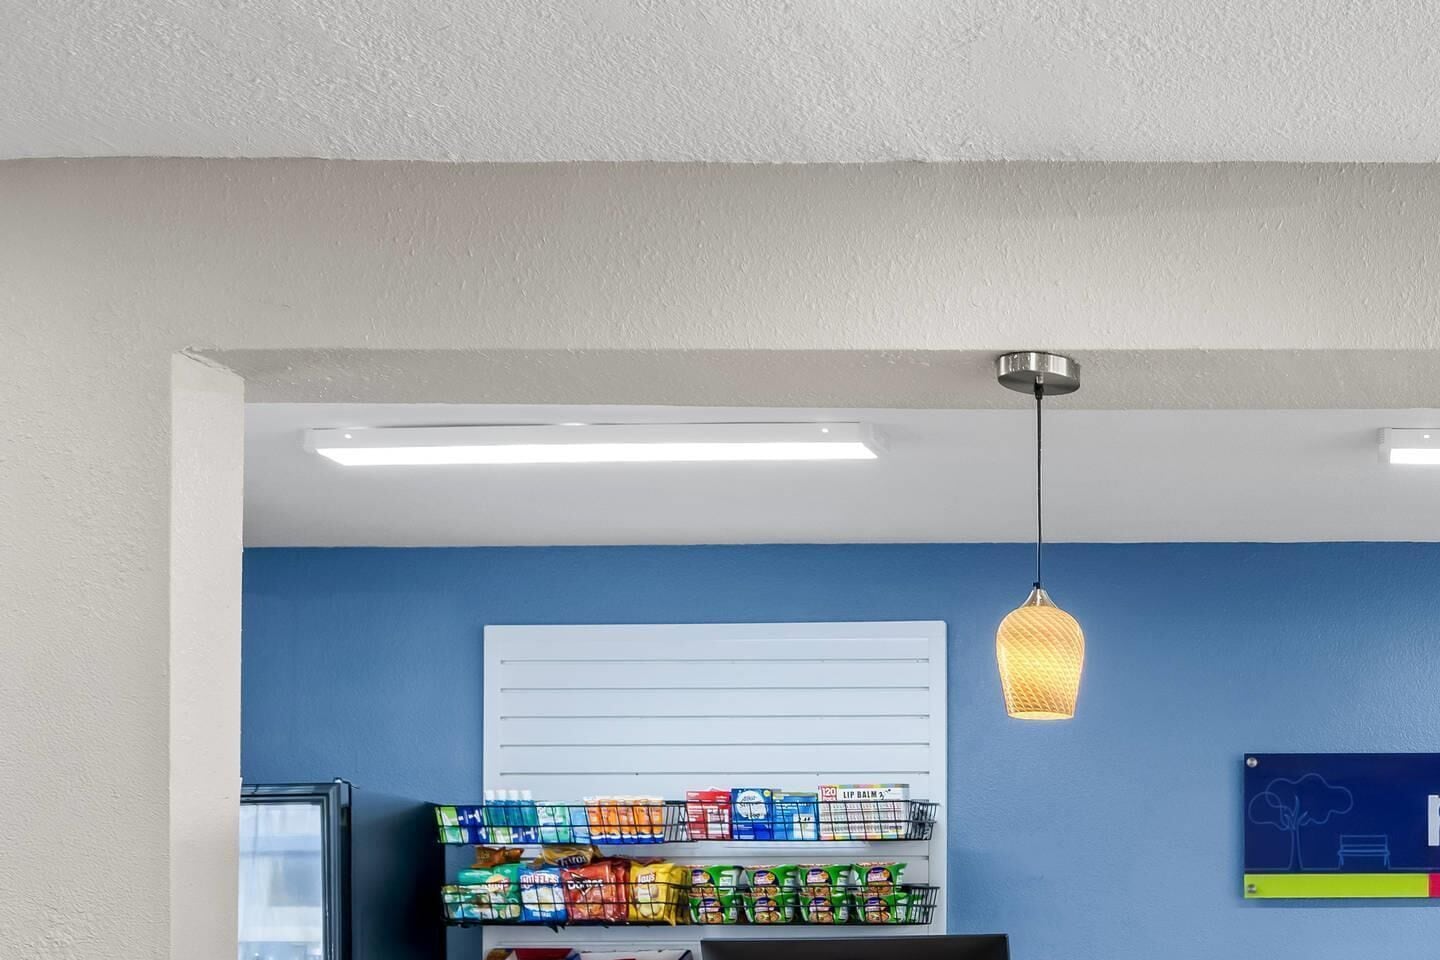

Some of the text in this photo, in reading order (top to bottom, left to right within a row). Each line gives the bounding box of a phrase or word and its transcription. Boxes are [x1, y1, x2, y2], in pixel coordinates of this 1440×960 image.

[822, 787, 837, 797] 120
[843, 791, 856, 799] LIP
[857, 790, 878, 799] BALM
